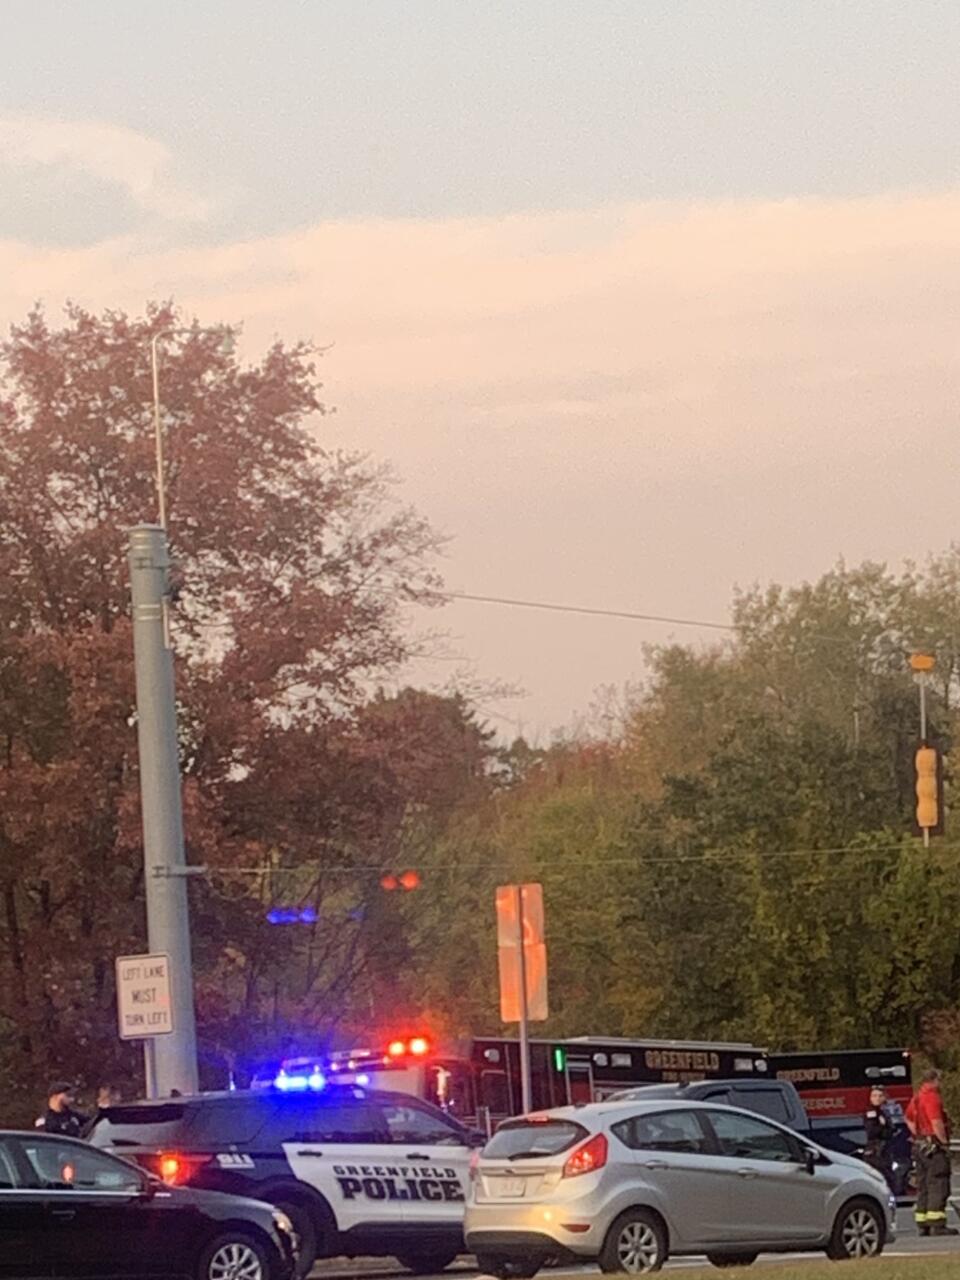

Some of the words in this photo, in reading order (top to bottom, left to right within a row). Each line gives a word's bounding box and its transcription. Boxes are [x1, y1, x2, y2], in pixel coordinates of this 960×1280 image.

[143, 965, 165, 979] LANE
[132, 986, 157, 1004] MUST
[146, 1010, 168, 1025] LEFT
[645, 1050, 720, 1070] GREENFIELD
[776, 1067, 841, 1082] GREENFIELD
[332, 1165, 457, 1178] GREENFIELD
[335, 1177, 466, 1202] POLICE
